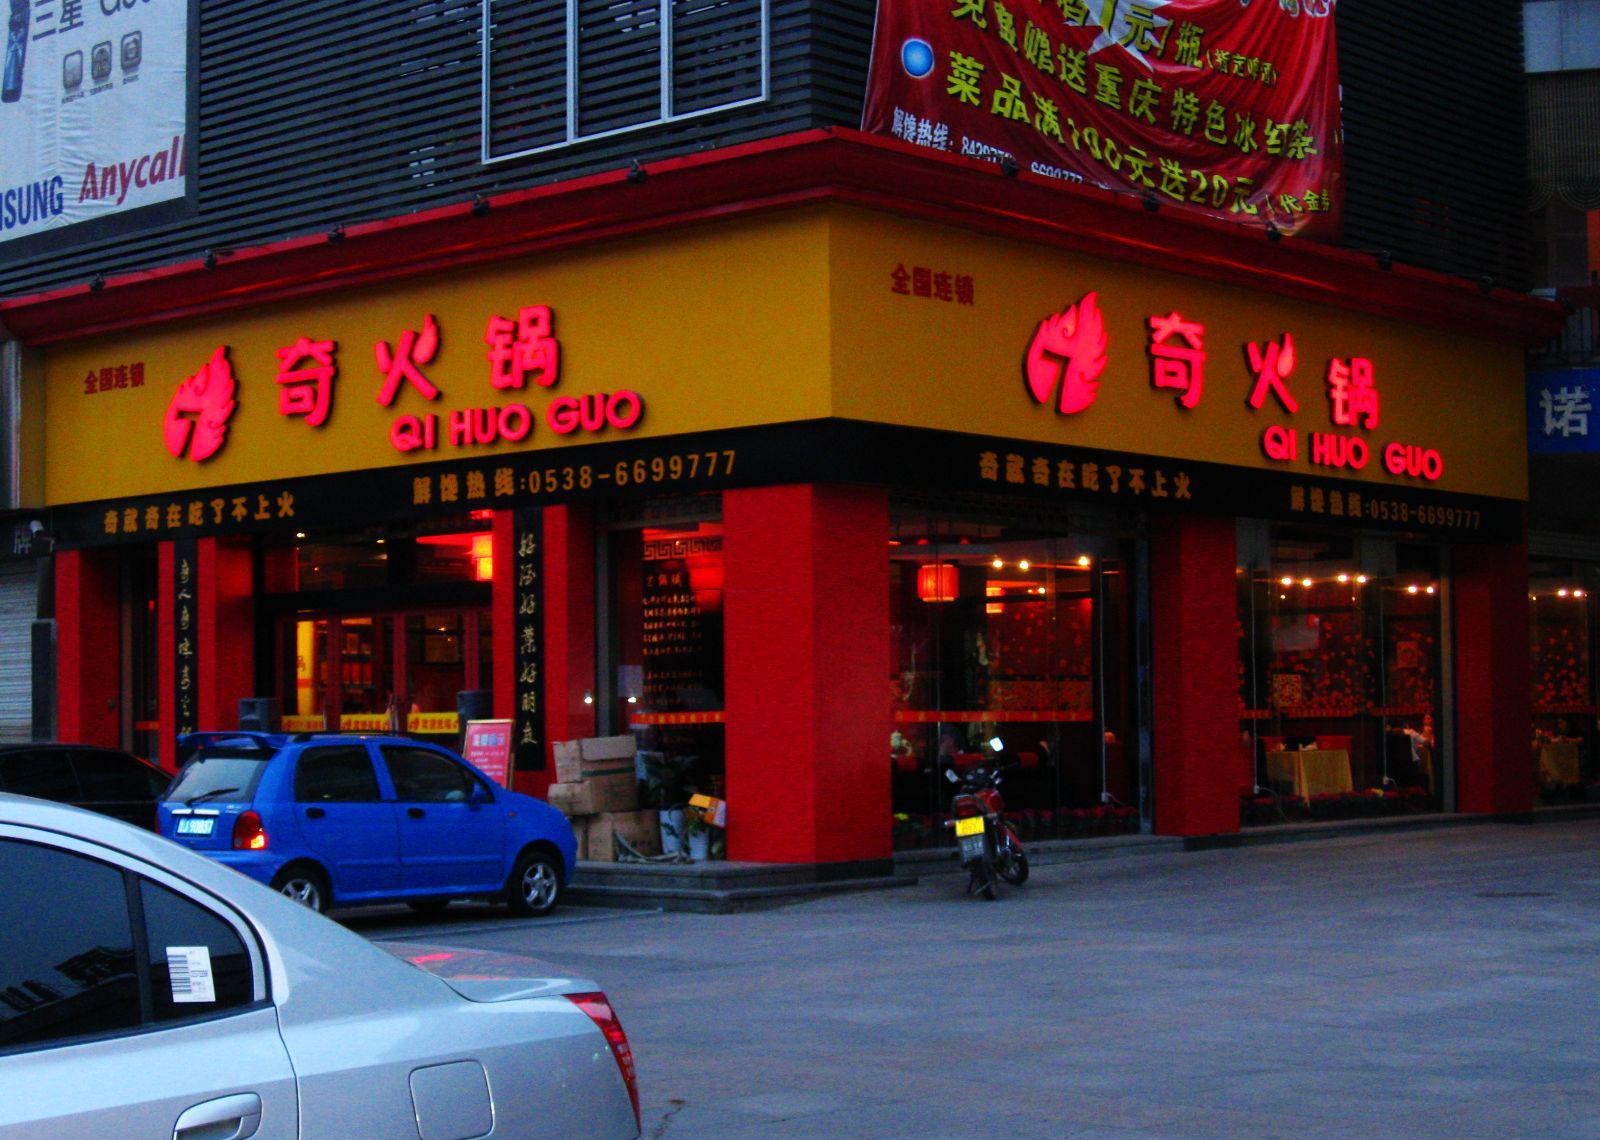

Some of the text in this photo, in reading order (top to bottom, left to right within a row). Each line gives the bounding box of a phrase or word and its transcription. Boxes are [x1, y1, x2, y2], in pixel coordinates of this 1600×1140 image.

[78, 134, 188, 206] Anycall
[0, 175, 64, 232] SUNG
[890, 263, 975, 307] 全国连锁
[82, 361, 146, 396] 全国连锁
[273, 303, 562, 428] 奇火锅
[1148, 309, 1381, 430] 奇火锅
[389, 389, 646, 453] QI HUO GUO
[1538, 384, 1593, 438] 诺
[1263, 425, 1444, 481] QI HUO GUO
